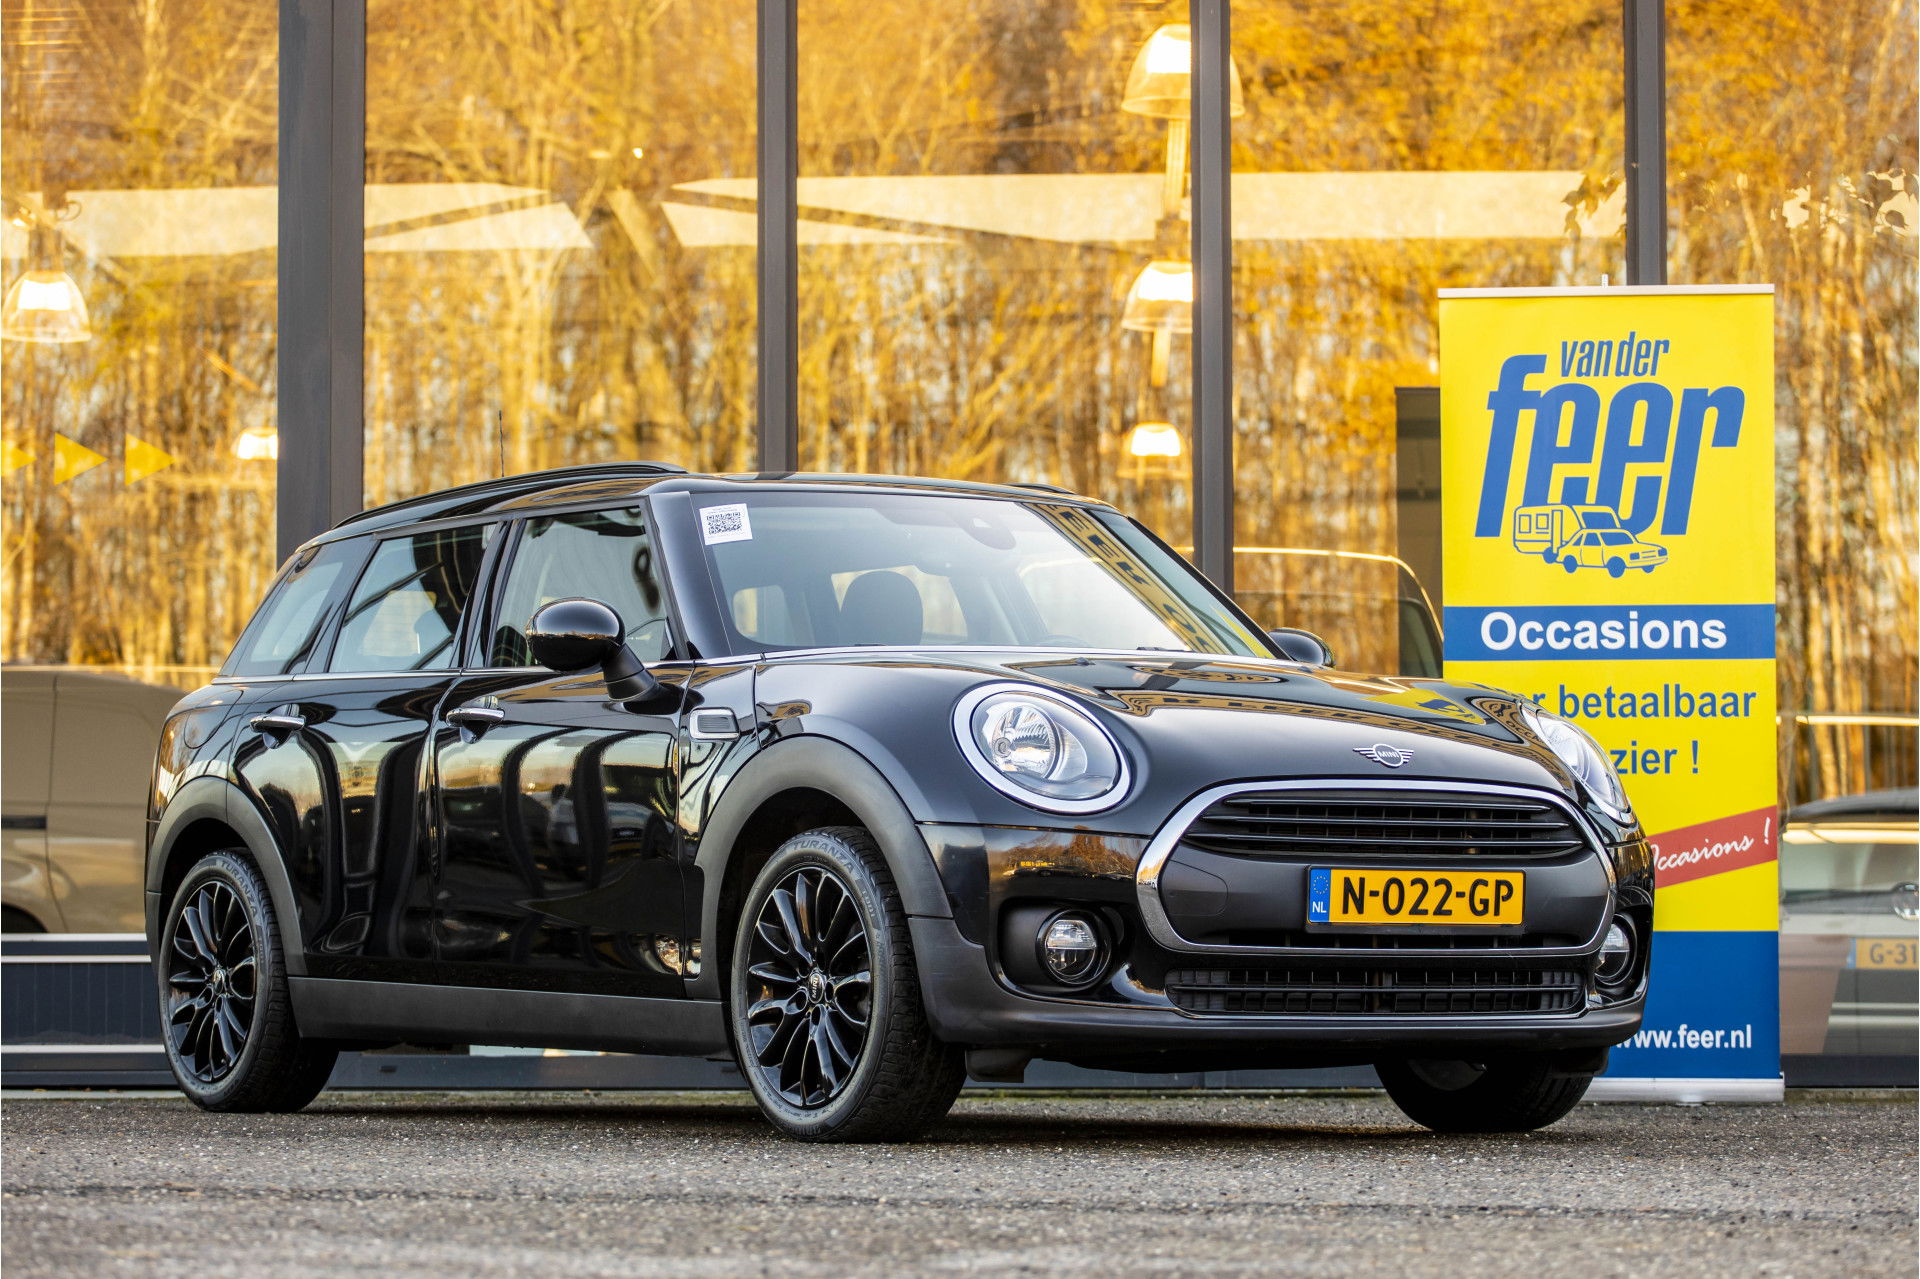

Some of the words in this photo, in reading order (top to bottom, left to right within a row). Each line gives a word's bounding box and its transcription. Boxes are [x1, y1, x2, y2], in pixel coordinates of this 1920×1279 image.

[1561, 340, 1613, 378] van
[1615, 331, 1670, 378] der
[1475, 353, 1746, 538] feer
[1480, 610, 1728, 651] Occasions
[1559, 683, 1757, 719] betaalbaar
[1377, 750, 1400, 758] MINI
[793, 840, 855, 873] TURANZA
[220, 861, 258, 918] TURANZA
[1312, 900, 1328, 914] NL
[1342, 876, 1514, 917] N-022-GP
